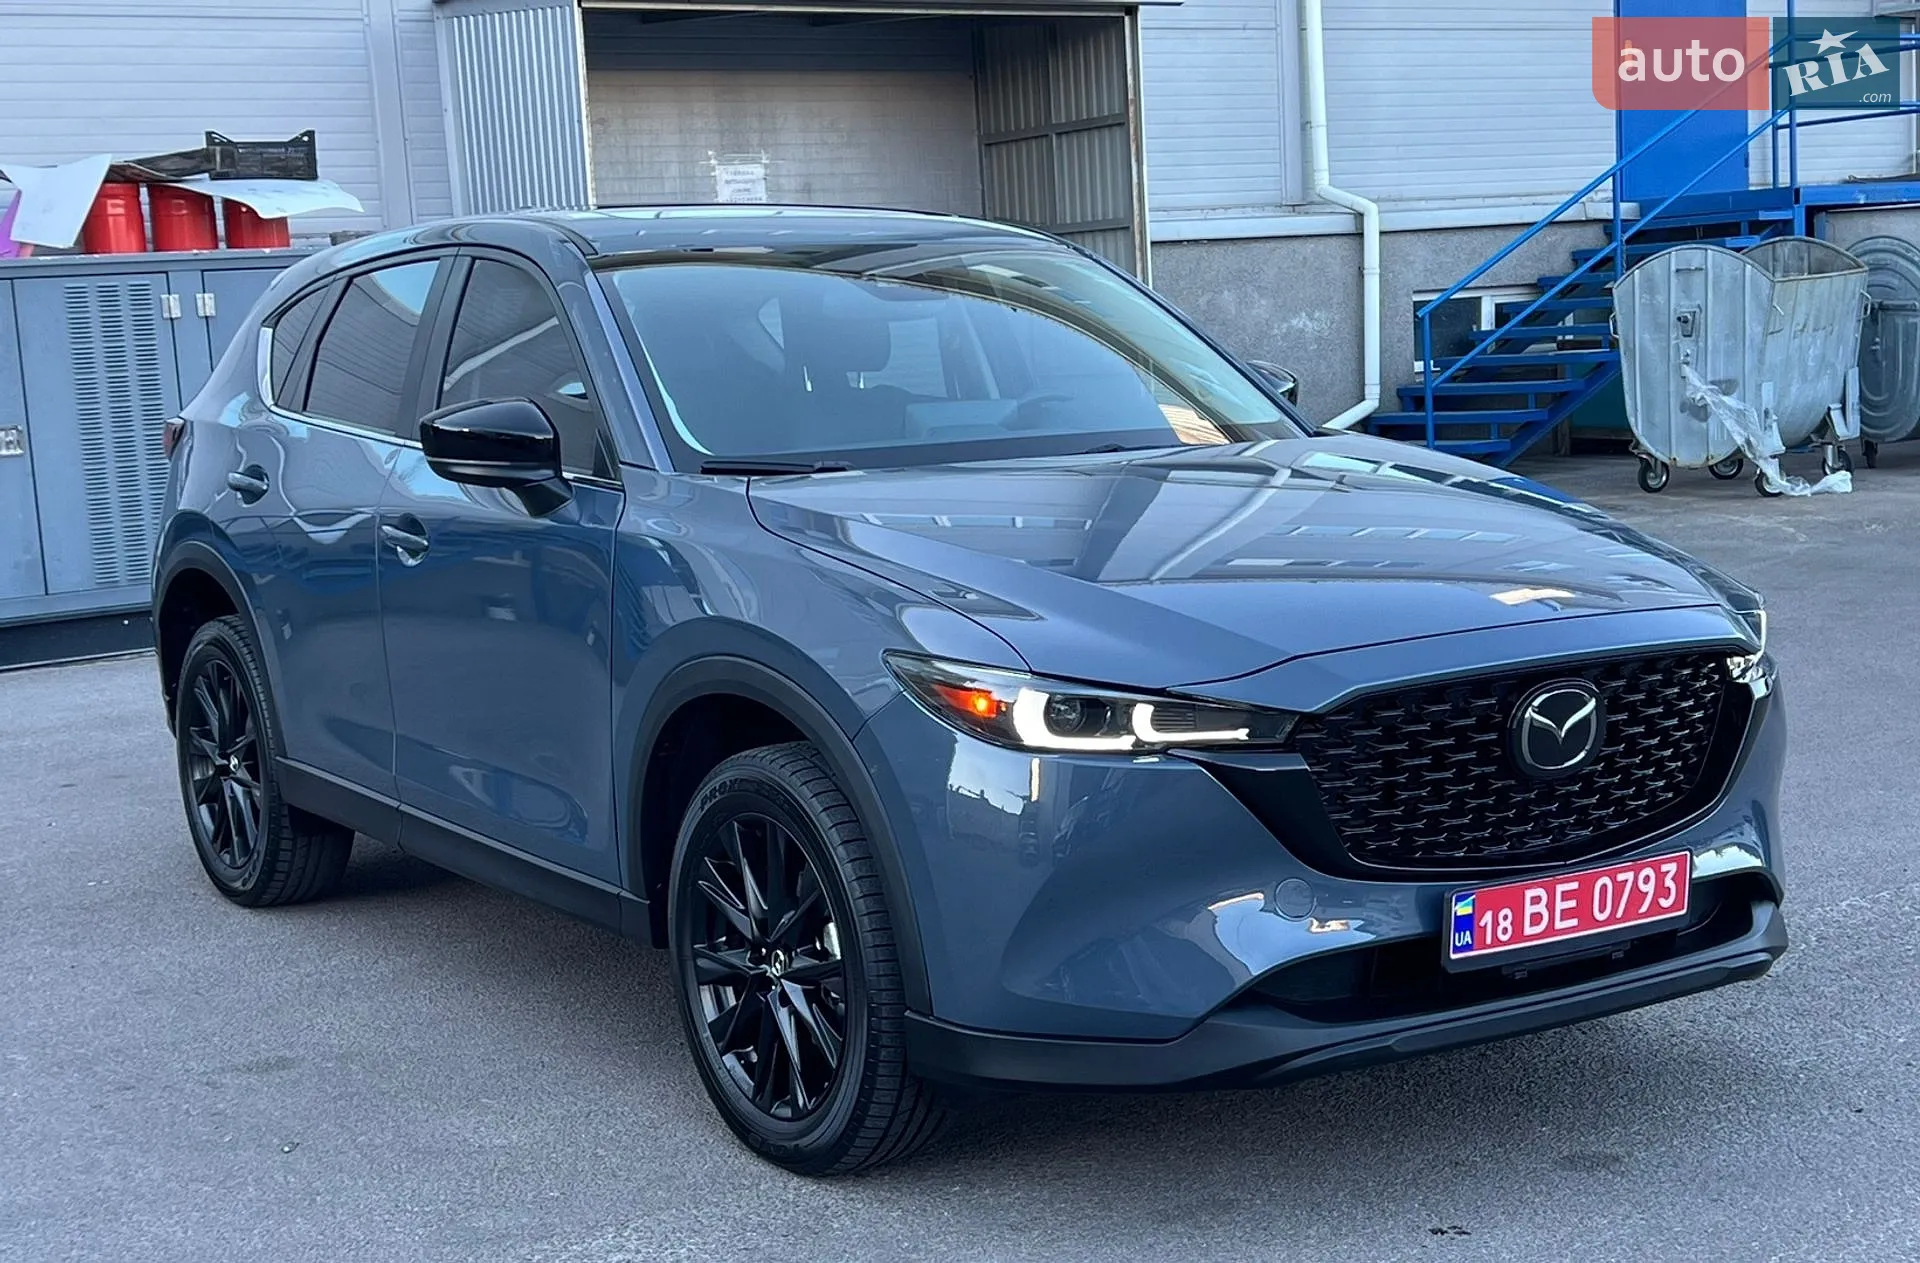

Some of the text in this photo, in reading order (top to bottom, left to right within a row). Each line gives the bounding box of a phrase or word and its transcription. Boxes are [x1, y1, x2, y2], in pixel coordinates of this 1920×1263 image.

[1478, 862, 1678, 945] 18 BE 0793
[1454, 929, 1473, 947] UA
